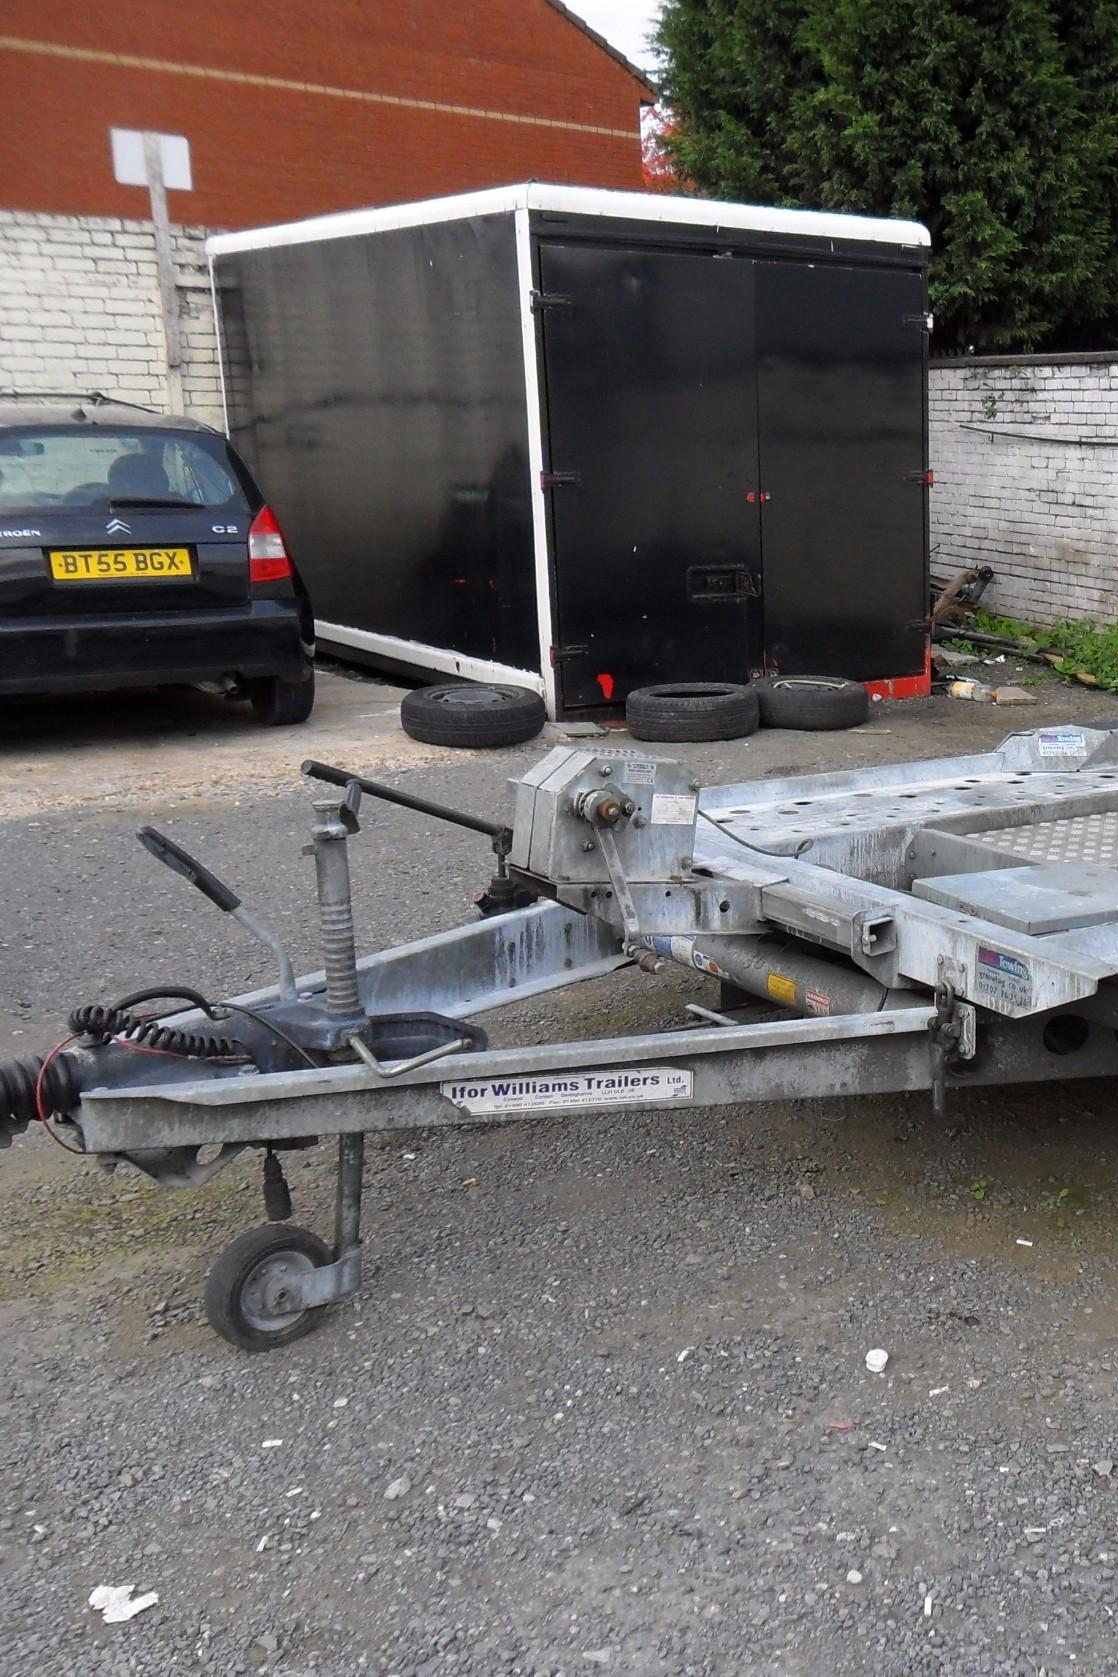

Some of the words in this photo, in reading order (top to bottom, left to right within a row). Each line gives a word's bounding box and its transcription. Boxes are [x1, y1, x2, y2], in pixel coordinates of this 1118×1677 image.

[211, 525, 239, 534] C2
[62, 553, 128, 574] BT55
[135, 551, 181, 571] BGX
[451, 1086, 488, 1099] Ifor
[491, 1081, 579, 1097] Williams
[584, 1075, 660, 1090] Trailers
[667, 1076, 685, 1085] Ltd.
